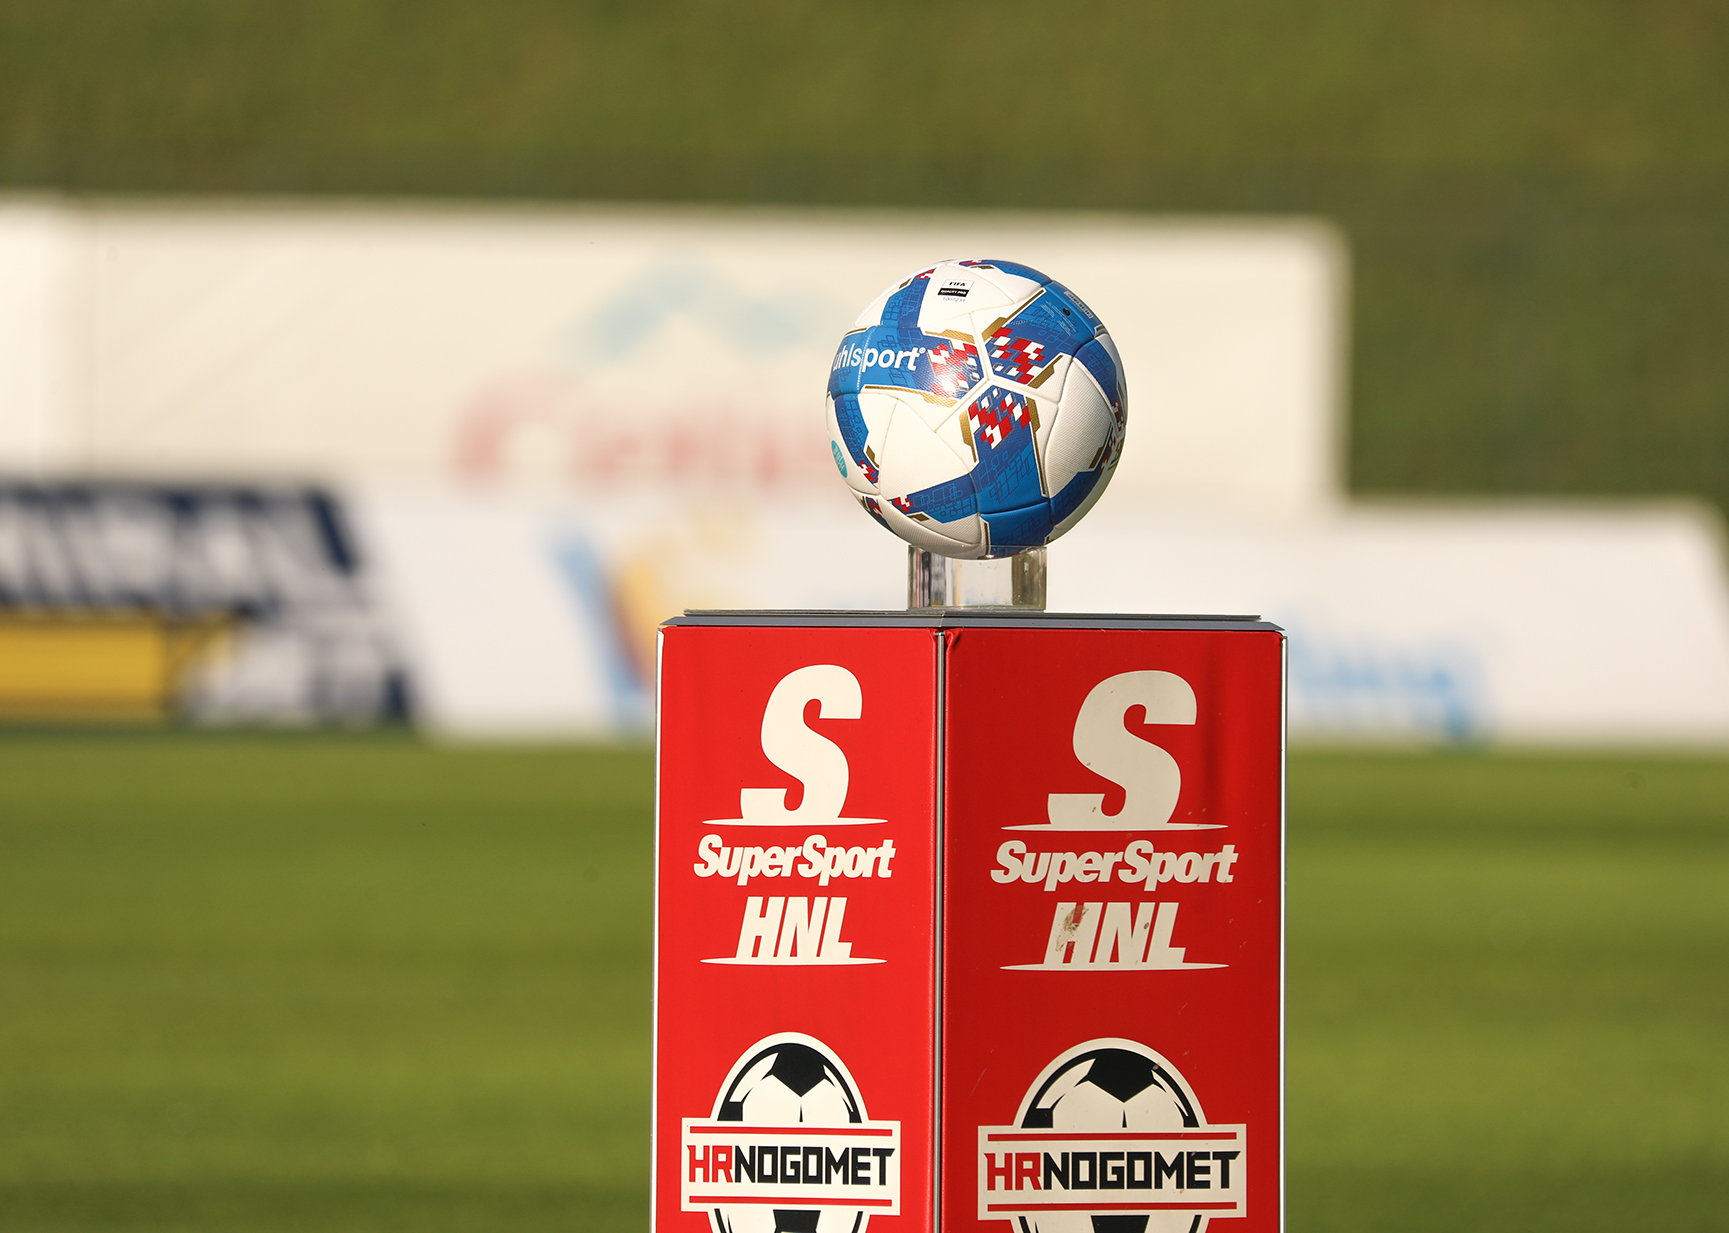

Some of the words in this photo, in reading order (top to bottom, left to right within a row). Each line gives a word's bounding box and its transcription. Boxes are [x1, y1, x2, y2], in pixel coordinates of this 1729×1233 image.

[833, 343, 920, 373] uhlsport
[693, 834, 896, 886] SuperSport
[990, 840, 1239, 892] SuperSport
[735, 896, 853, 959] HNL
[1043, 902, 1187, 965] HNL
[686, 1145, 896, 1186] HRNOGOMET
[984, 1151, 1241, 1191] HRNOGOMET
